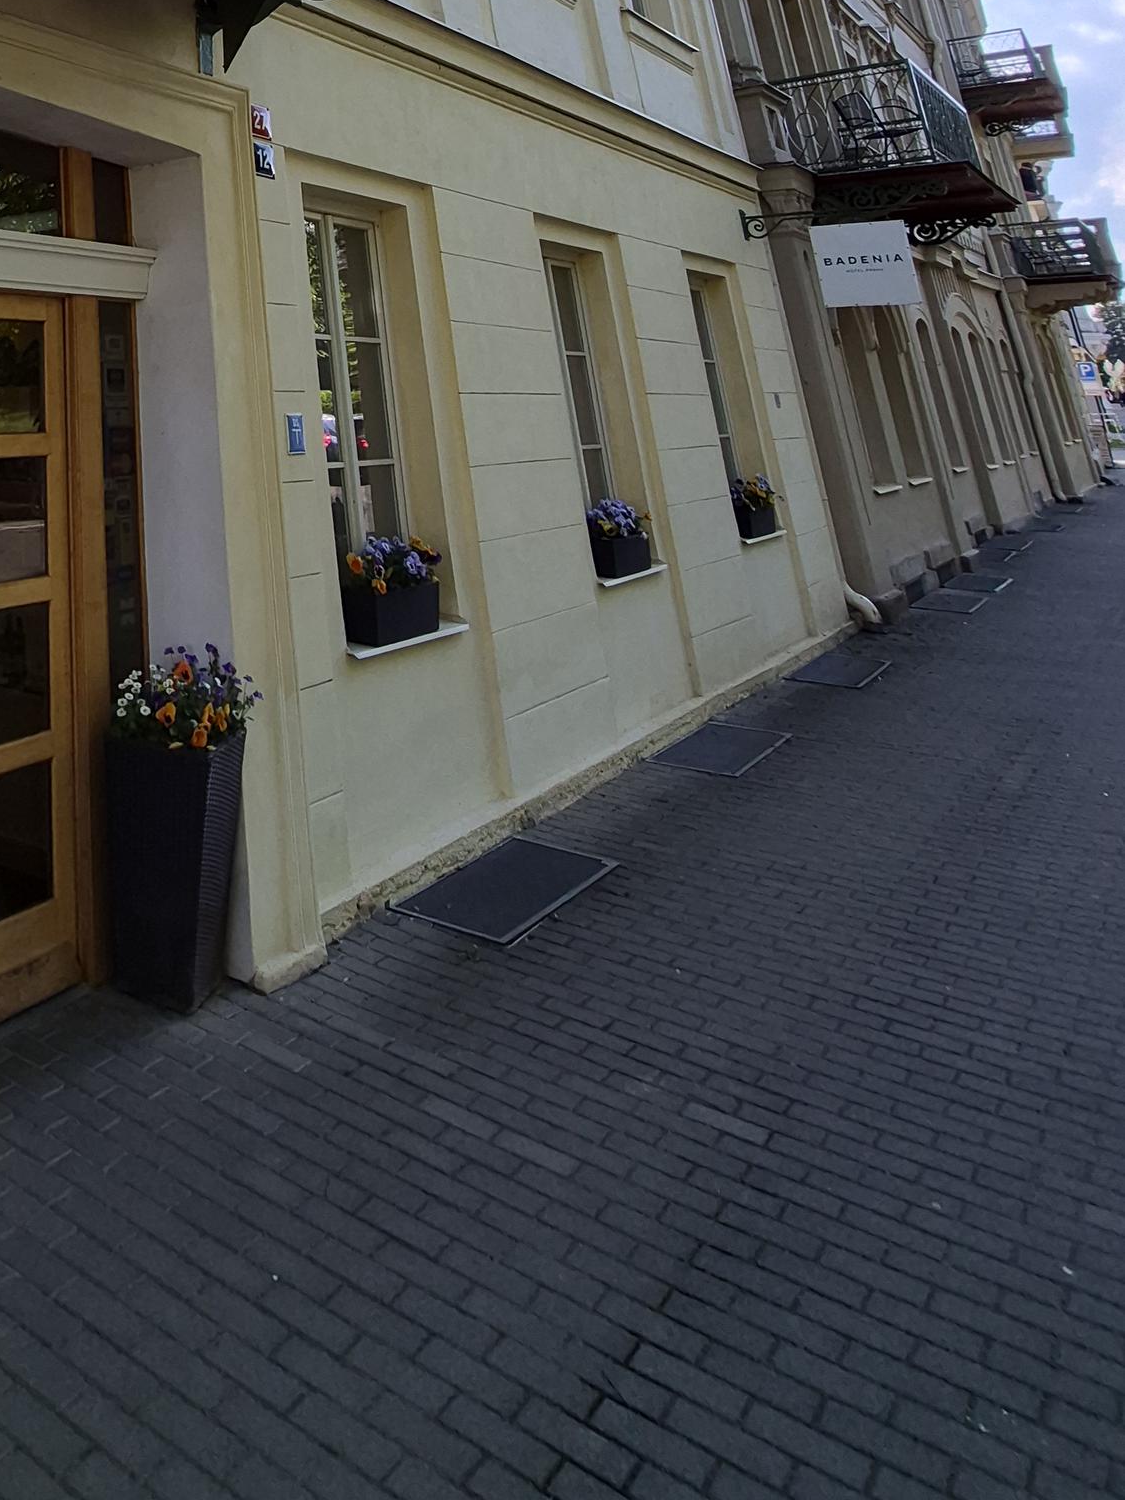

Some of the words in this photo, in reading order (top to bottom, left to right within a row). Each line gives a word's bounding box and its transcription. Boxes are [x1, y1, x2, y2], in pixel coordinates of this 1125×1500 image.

[257, 149, 270, 169] 12
[823, 253, 904, 267] BADENIA
[1079, 364, 1092, 376] P
